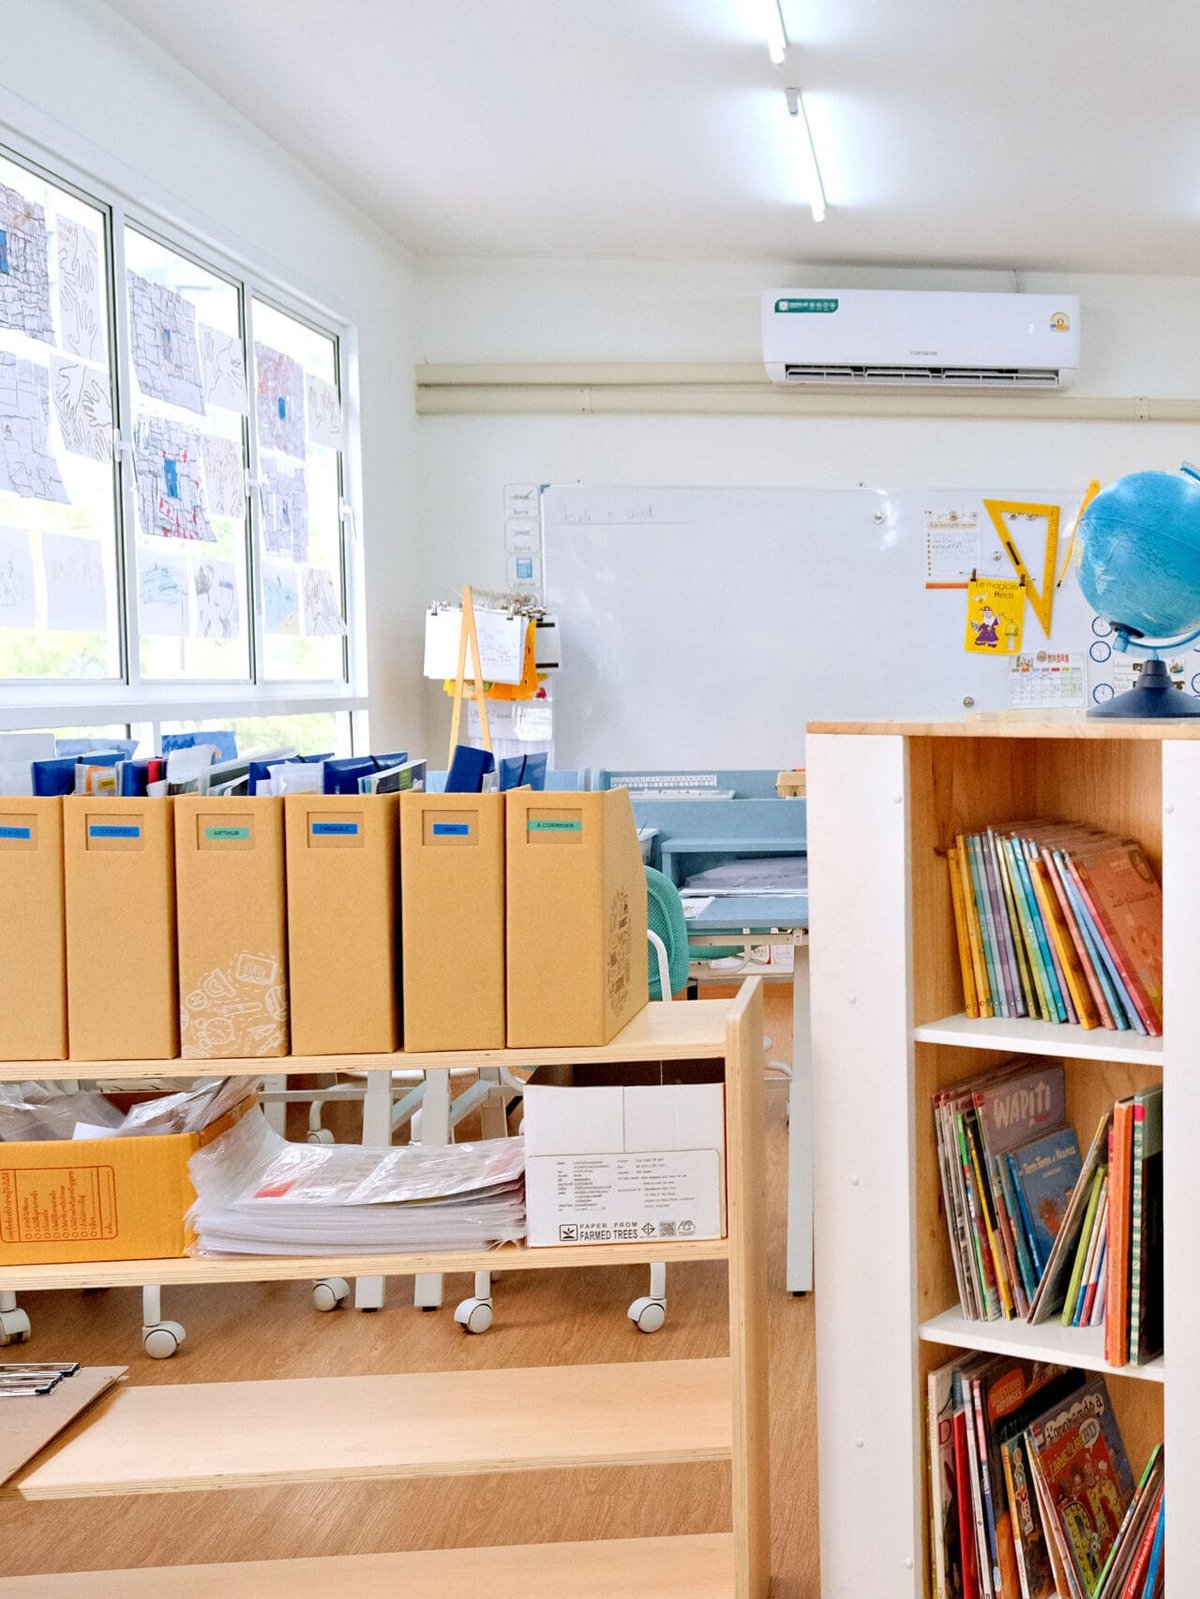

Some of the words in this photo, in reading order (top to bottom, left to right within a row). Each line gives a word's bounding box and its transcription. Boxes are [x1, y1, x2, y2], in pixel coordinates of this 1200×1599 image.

[993, 1082, 1051, 1129] WAPITI
[579, 1222, 608, 1230] PAPER
[579, 1229, 611, 1241] FARMED
[613, 1228, 638, 1240] TREES
